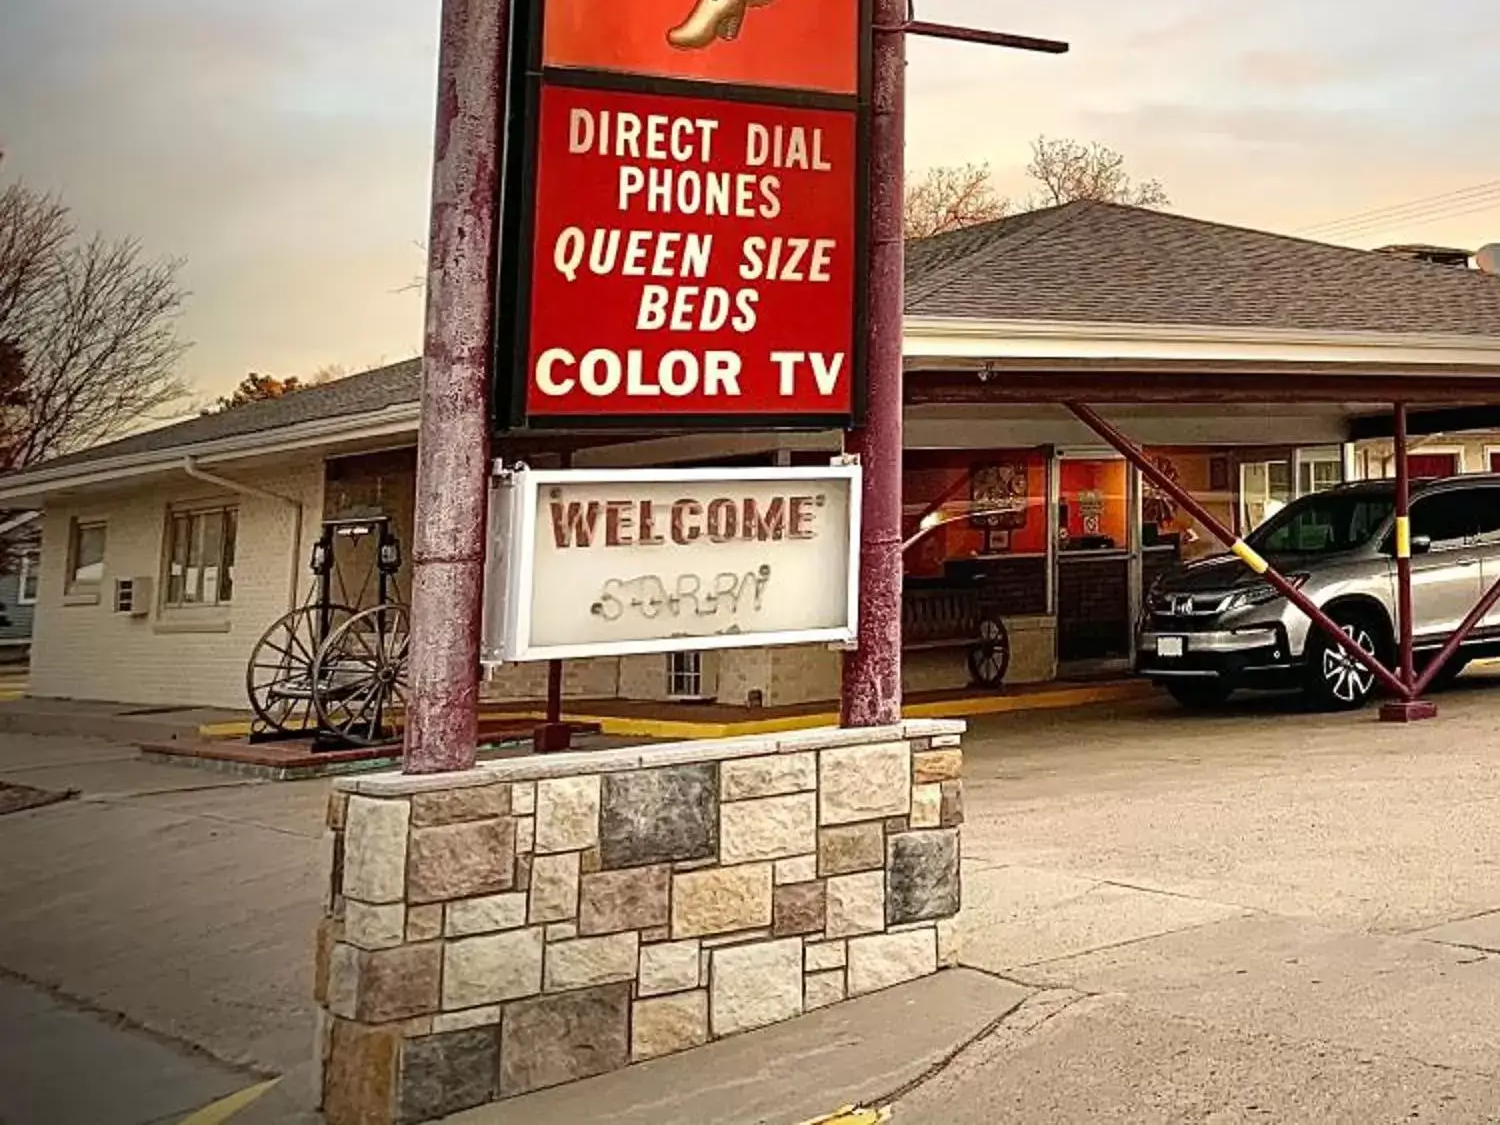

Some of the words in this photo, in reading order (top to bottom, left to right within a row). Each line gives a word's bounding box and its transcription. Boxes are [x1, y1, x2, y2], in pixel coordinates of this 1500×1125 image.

[569, 108, 718, 163] DIRECT
[746, 123, 831, 171] DIAL
[618, 165, 781, 218] PHONES
[554, 226, 713, 282] QUEEN
[739, 236, 837, 283] SIZE
[636, 284, 759, 332] BEDS
[535, 348, 742, 396] COLOR
[770, 352, 844, 395] TV
[550, 495, 818, 548] WELCOME
